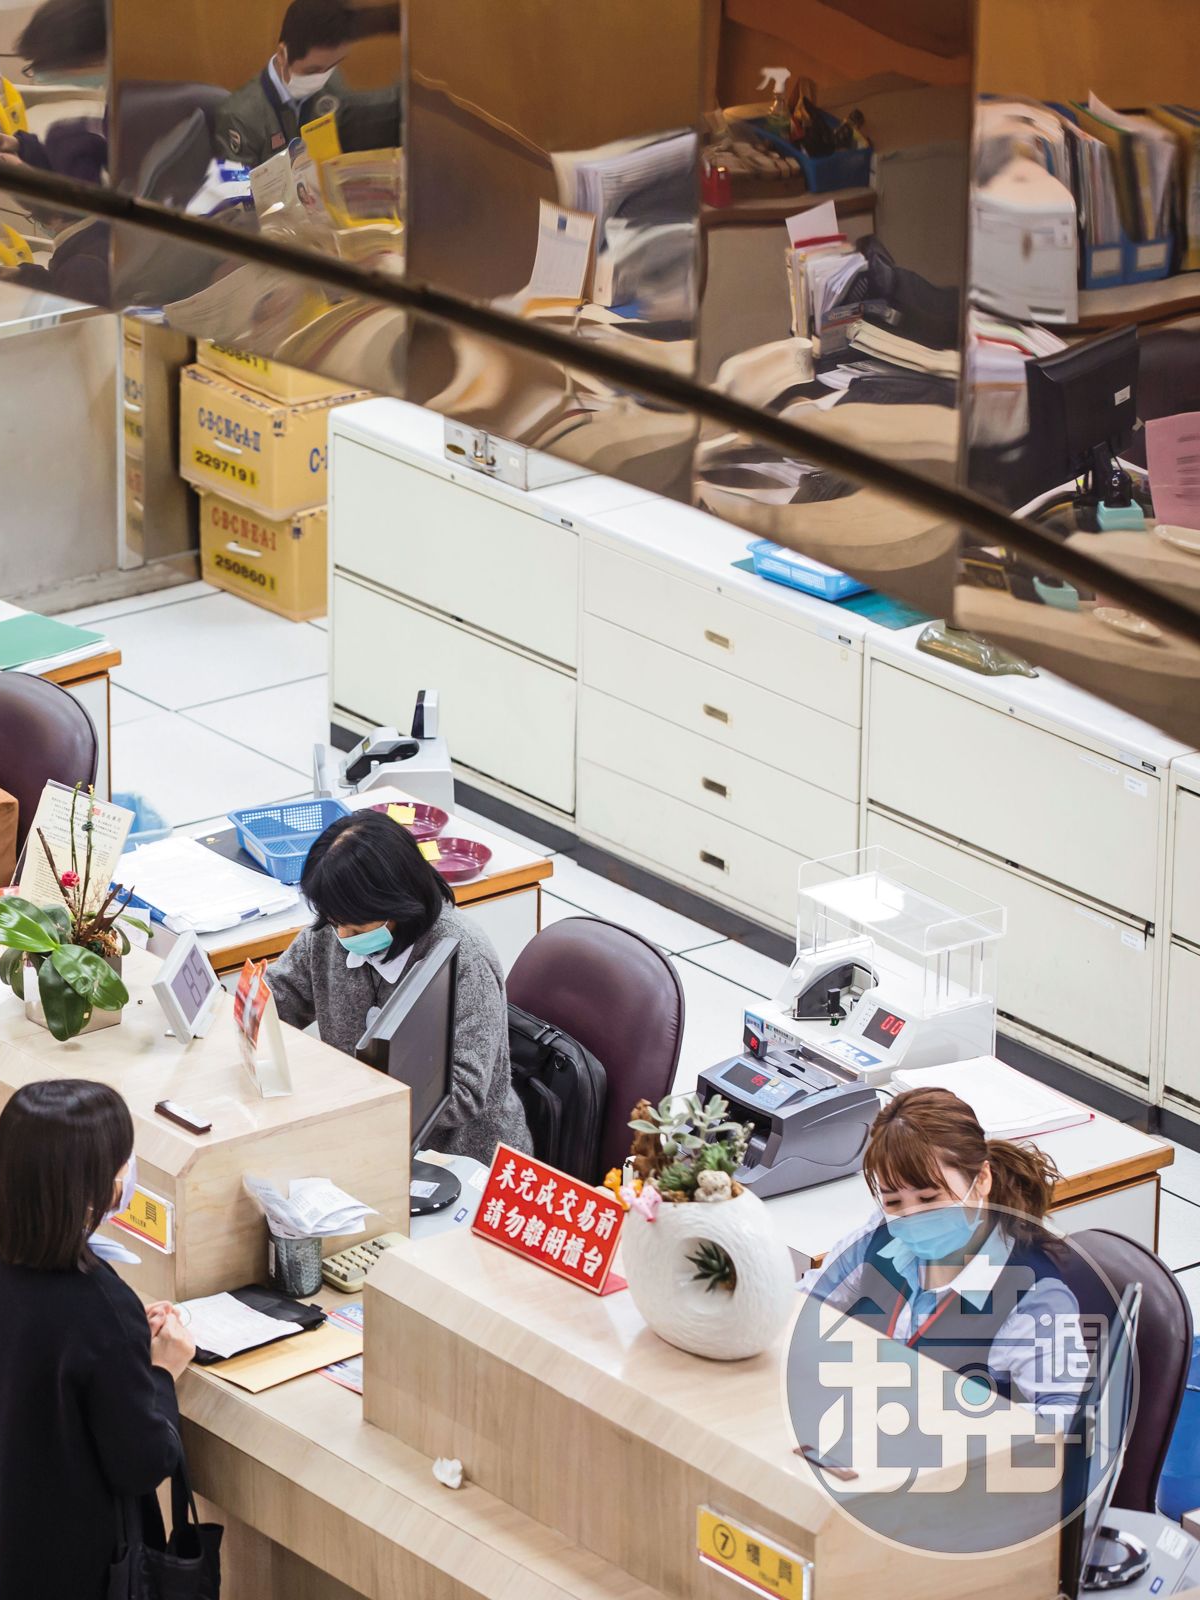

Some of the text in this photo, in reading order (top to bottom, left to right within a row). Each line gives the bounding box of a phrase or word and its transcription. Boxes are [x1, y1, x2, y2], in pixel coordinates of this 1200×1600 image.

[482, 1196, 604, 1278] 請勿離開櫃台
[495, 1158, 618, 1241] 未完成交易前
